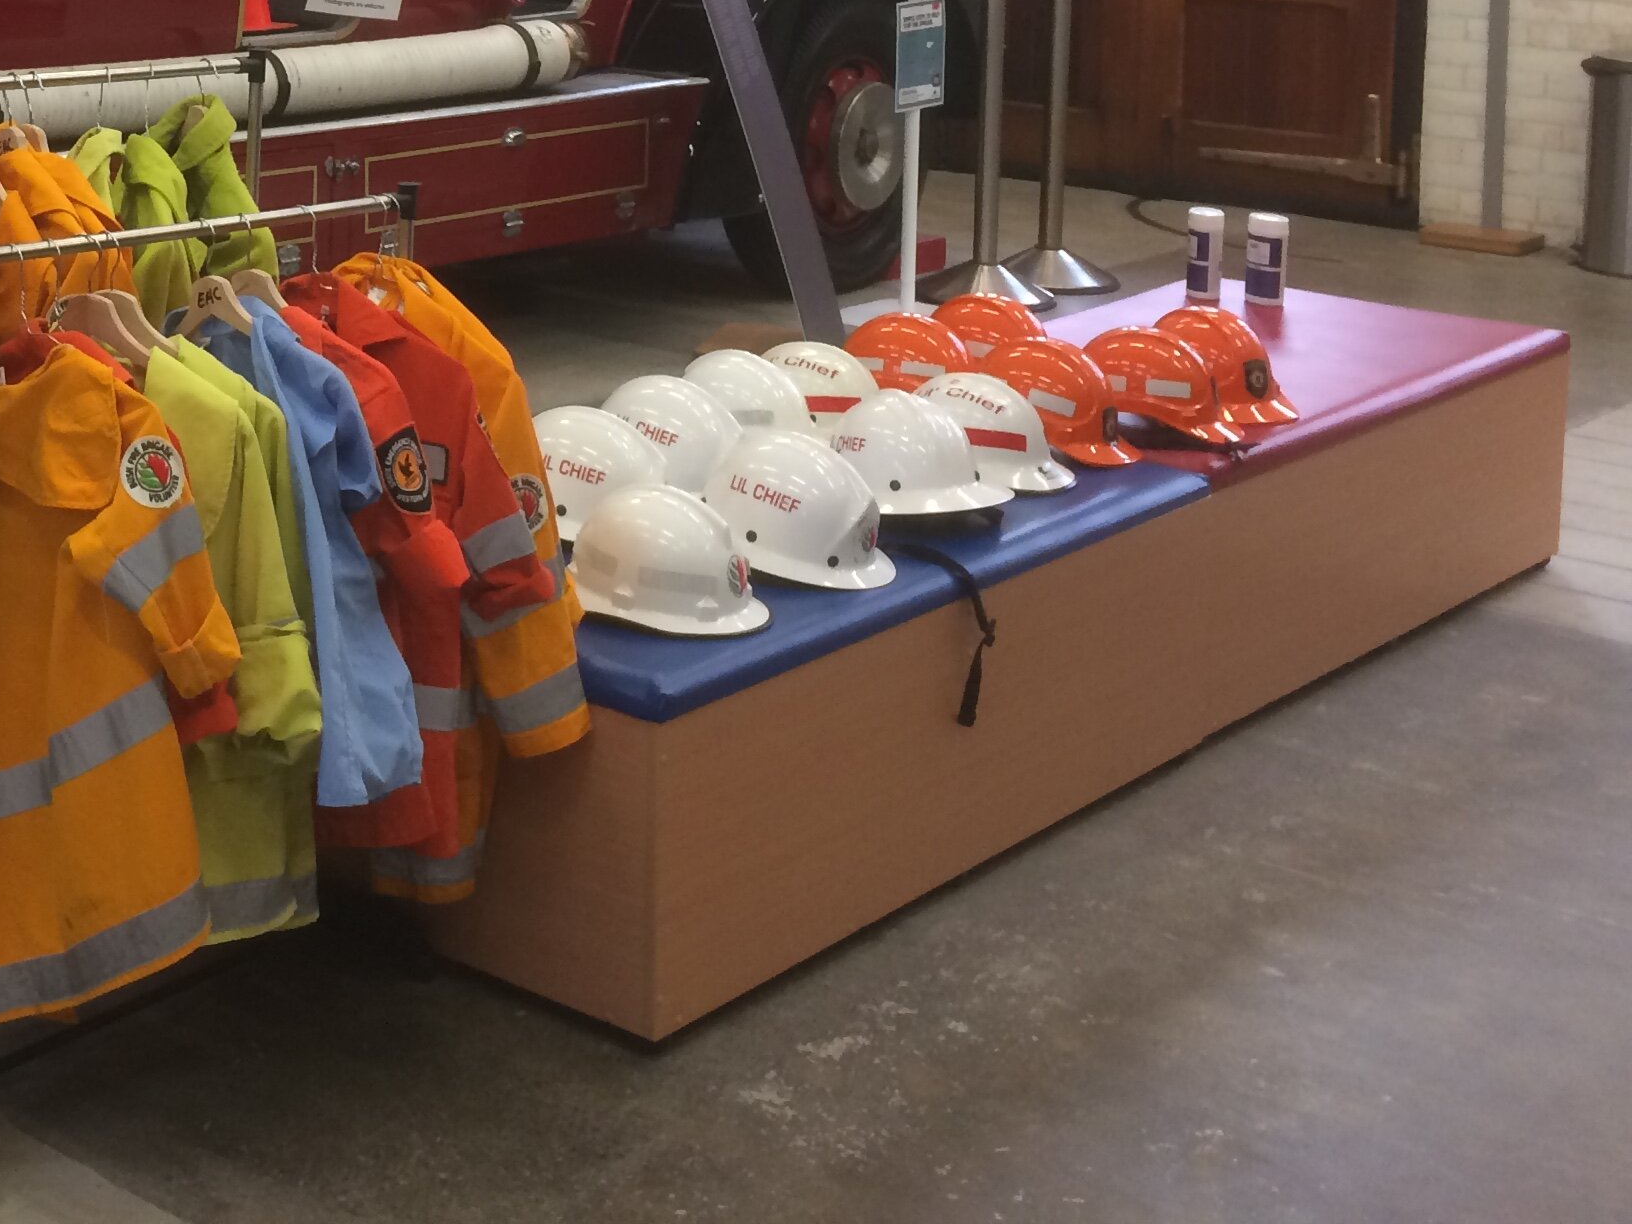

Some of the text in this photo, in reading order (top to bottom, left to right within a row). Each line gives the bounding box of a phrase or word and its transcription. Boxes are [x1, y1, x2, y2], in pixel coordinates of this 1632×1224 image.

[784, 356, 840, 379] Chief
[946, 387, 1007, 415] Chief
[636, 420, 679, 447] CHIEF
[836, 435, 867, 453] CHIEF
[559, 459, 607, 485] CHIEF
[730, 474, 802, 513] LIL CHIEF
